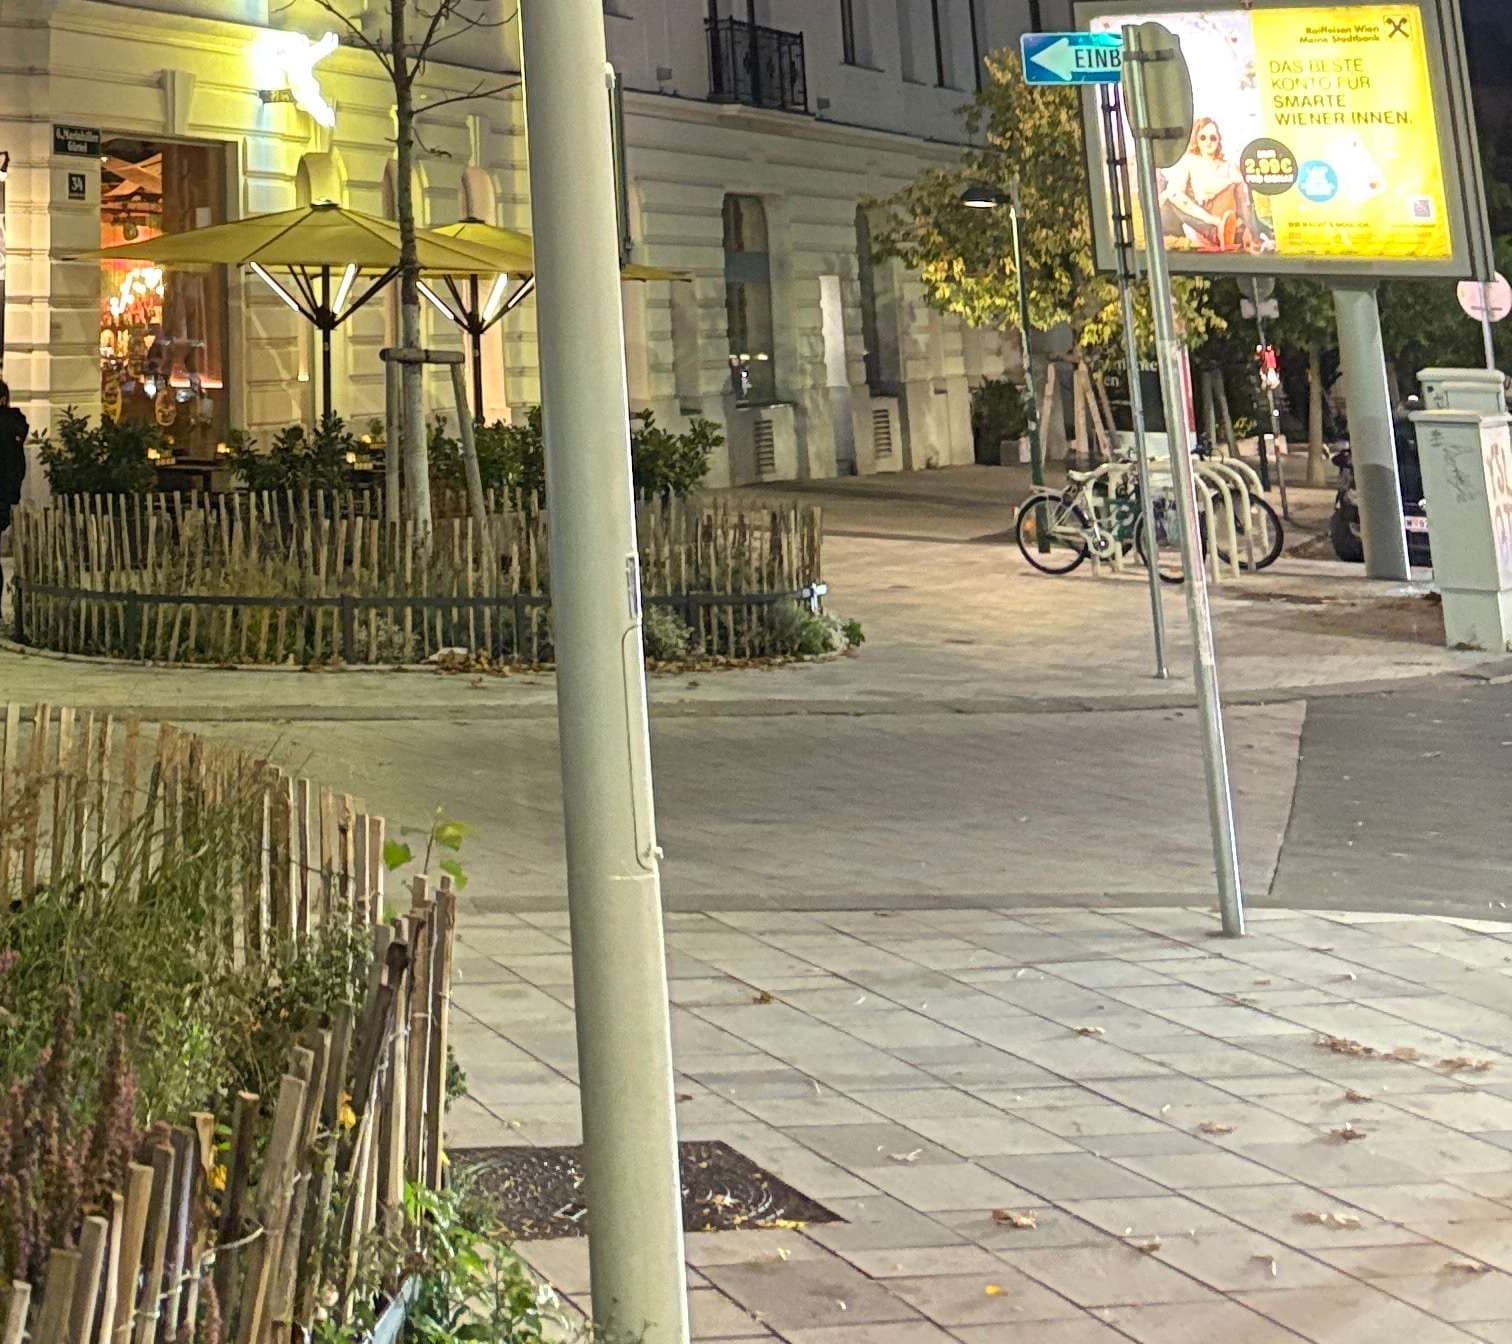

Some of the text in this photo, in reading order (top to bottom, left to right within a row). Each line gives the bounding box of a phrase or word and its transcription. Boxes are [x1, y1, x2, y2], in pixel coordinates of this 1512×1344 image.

[1354, 25, 1380, 33] Wien
[1074, 48, 1122, 69] EINB
[1270, 58, 1364, 74] DAS BESTE
[1272, 77, 1331, 91] KONTO
[1273, 95, 1347, 108] SMARTE
[71, 176, 84, 192] 34
